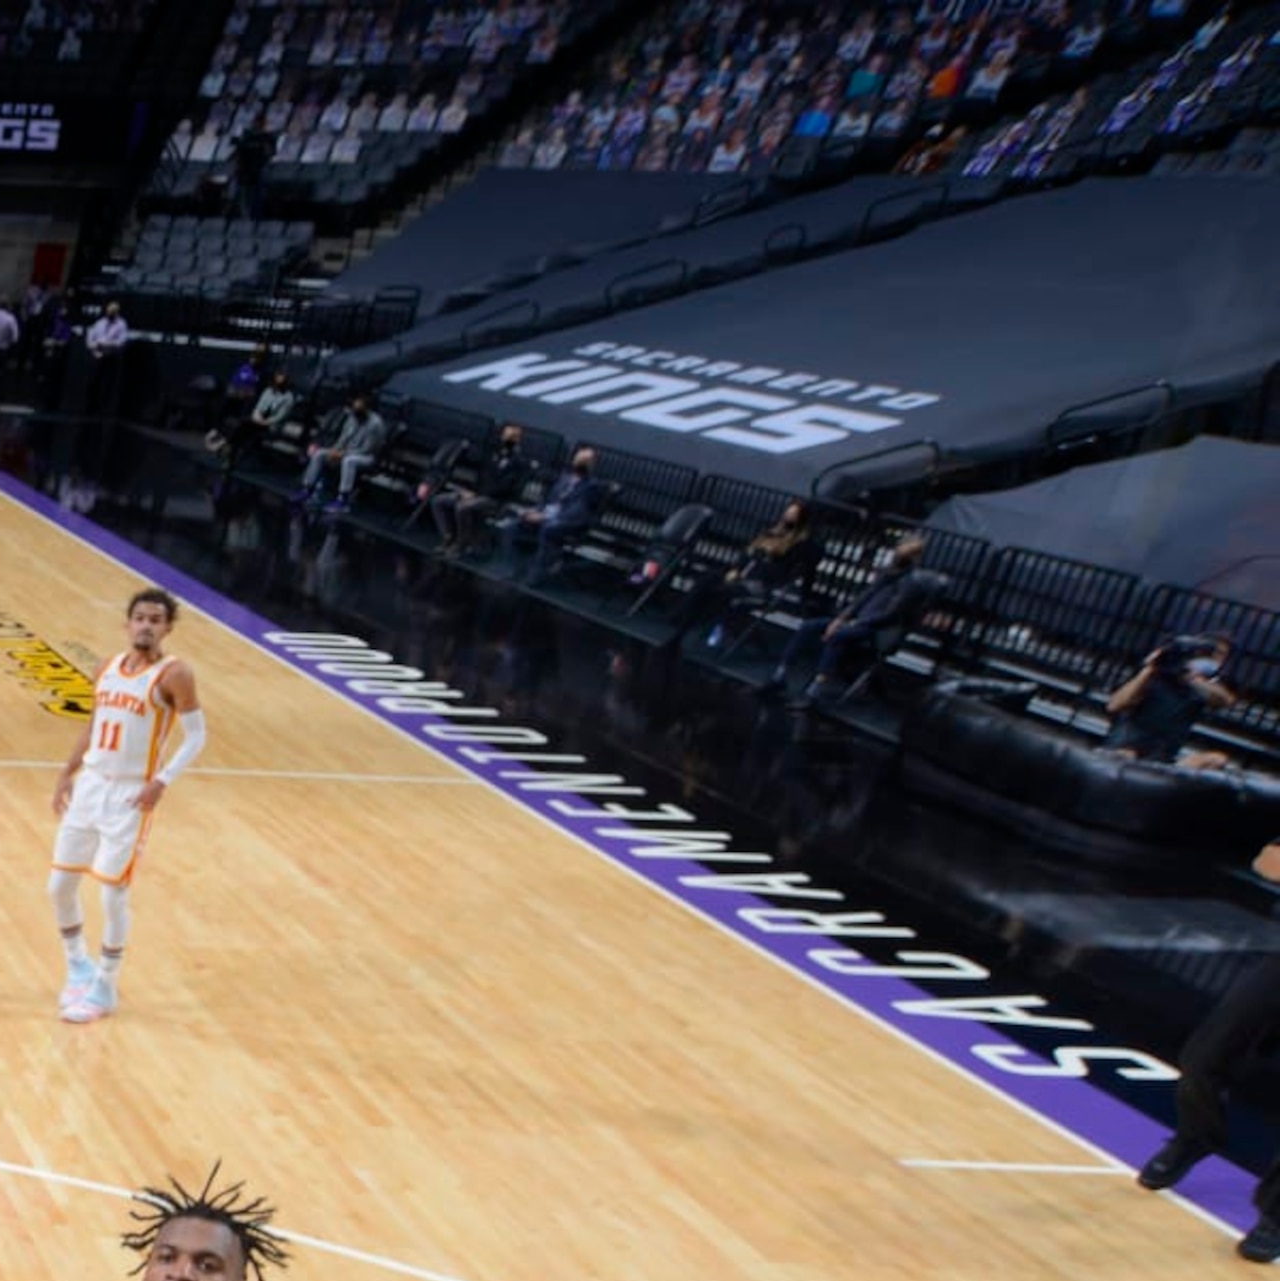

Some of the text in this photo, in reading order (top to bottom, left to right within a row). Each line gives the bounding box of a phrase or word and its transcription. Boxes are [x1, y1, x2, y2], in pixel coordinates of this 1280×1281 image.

[441, 352, 905, 454] KINGS
[573, 341, 942, 411] SACRAMENTO
[263, 632, 500, 717] PROUD
[98, 720, 123, 751] 11
[422, 723, 1182, 1082] SACRAMENTO
